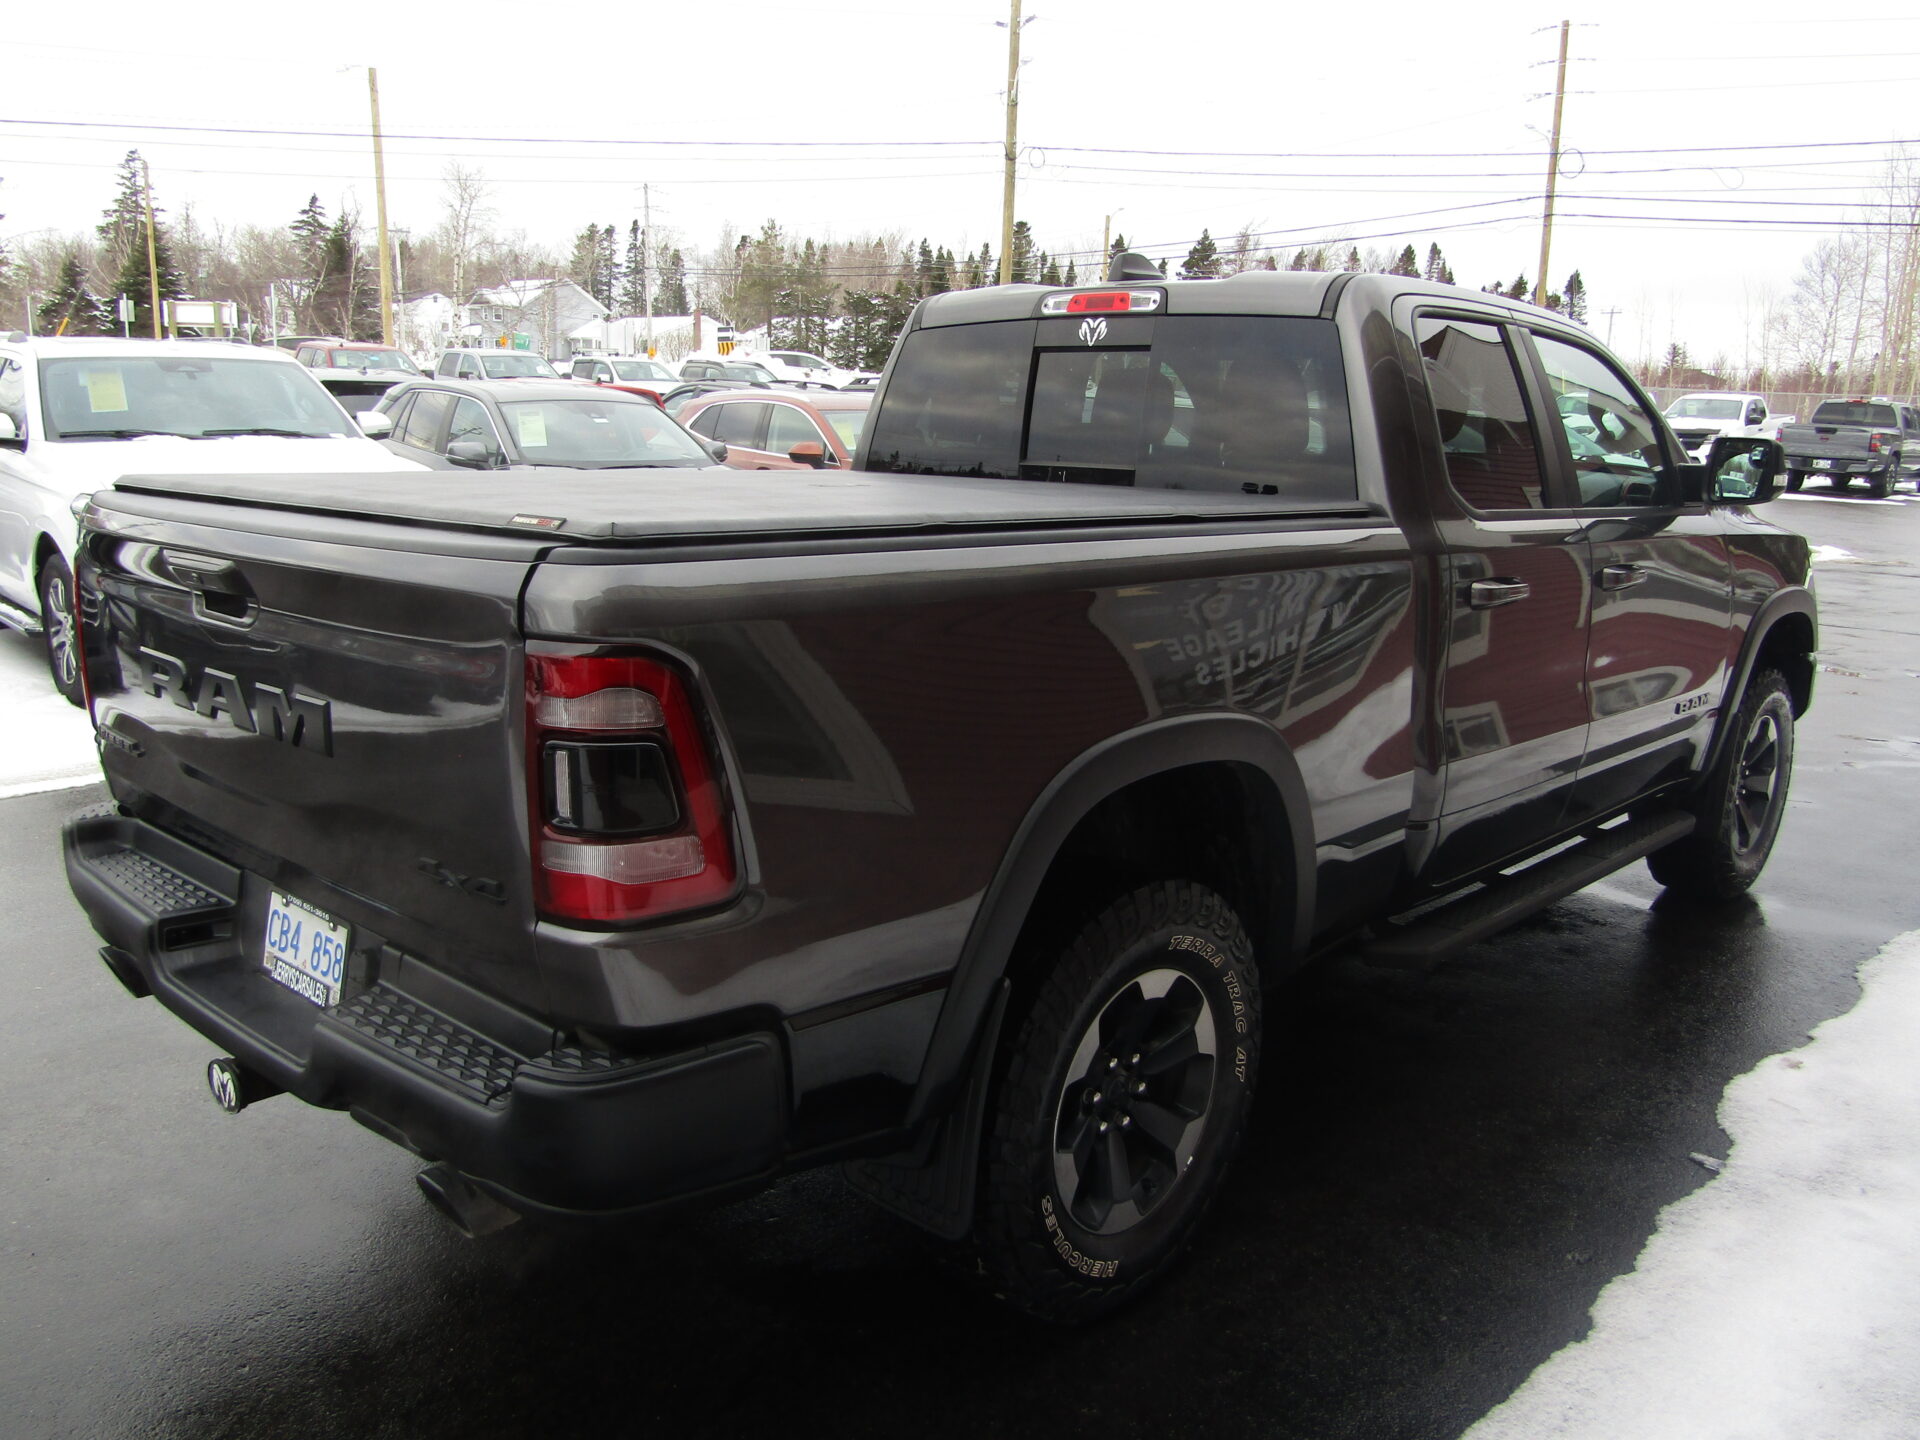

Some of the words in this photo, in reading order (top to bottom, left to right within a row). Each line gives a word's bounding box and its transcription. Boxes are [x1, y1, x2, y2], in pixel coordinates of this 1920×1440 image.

[138, 646, 334, 758] RAM
[1674, 693, 1709, 715] RAM
[268, 908, 302, 960] CB4
[310, 931, 344, 983] 858
[1168, 935, 1224, 968] TERRA
[1222, 971, 1246, 1034] TRAC
[1234, 1047, 1246, 1082] AT
[1042, 1195, 1119, 1278] HERCULES
